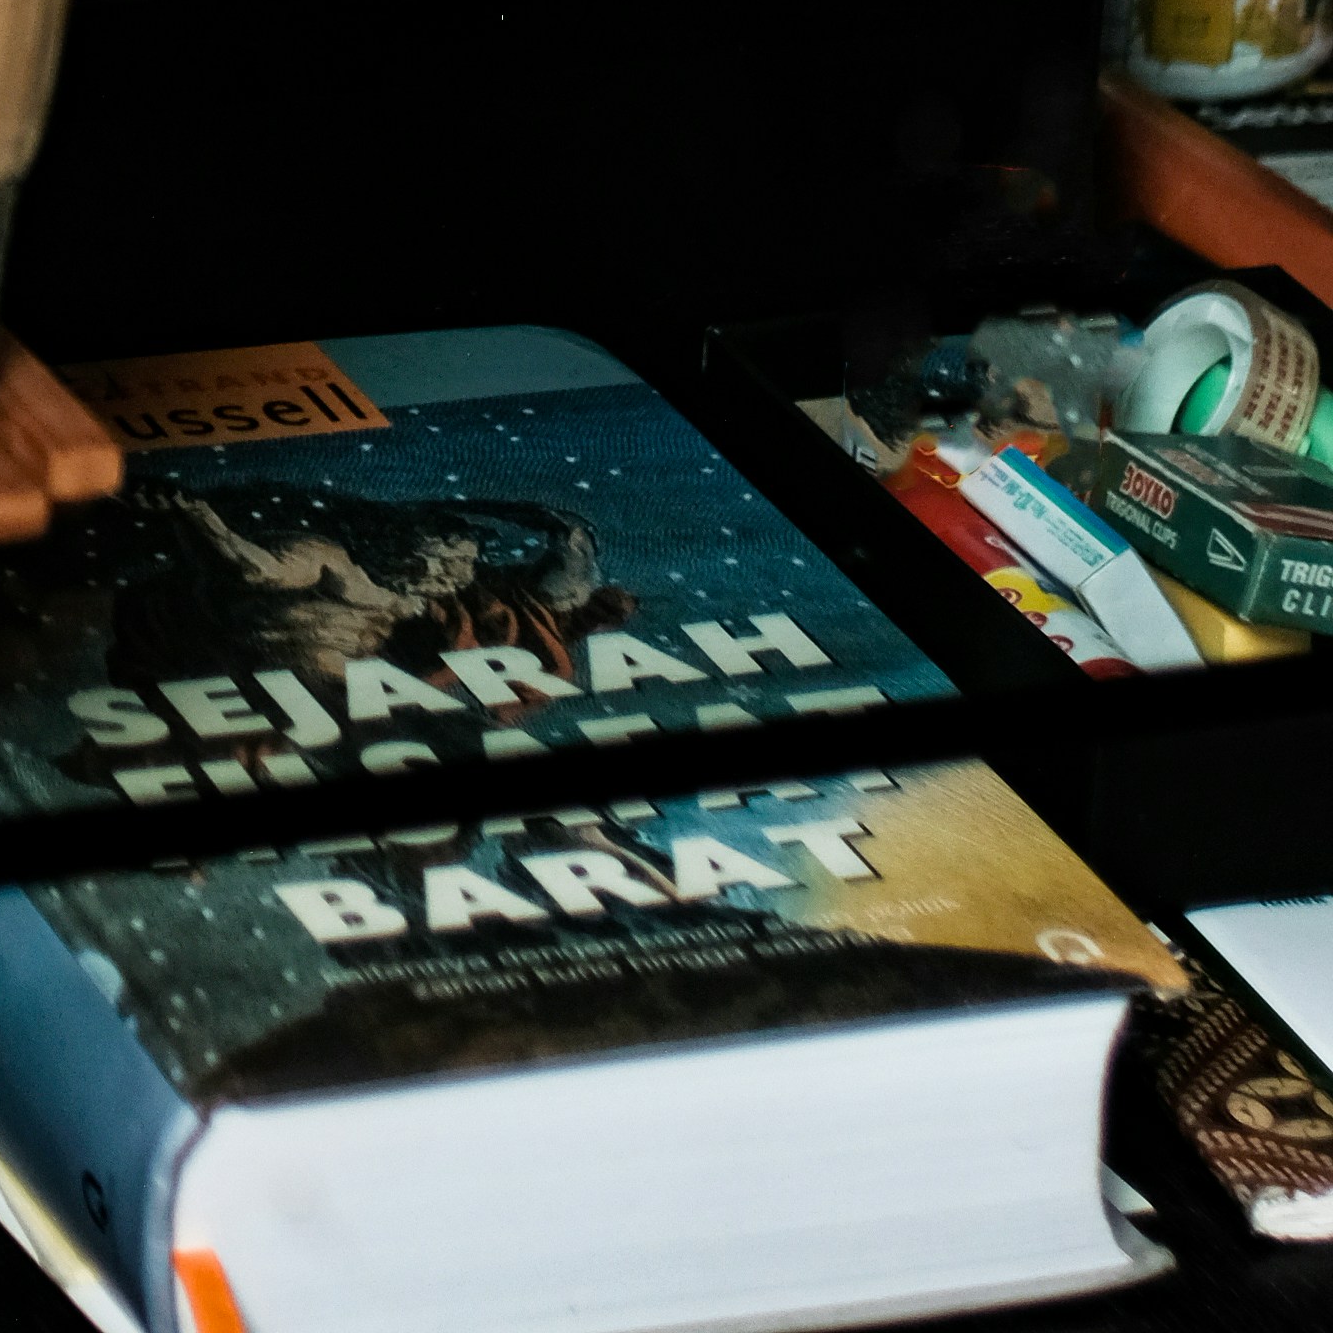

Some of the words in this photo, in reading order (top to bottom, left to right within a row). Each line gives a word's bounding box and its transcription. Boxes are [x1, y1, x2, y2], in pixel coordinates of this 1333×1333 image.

[113, 381, 368, 440] ussell
[1119, 460, 1179, 519] JOYKO
[1280, 558, 1333, 588] TRIG
[1281, 588, 1333, 617] CLI
[67, 612, 833, 749] SEJARAH
[273, 817, 884, 947] BARAT
